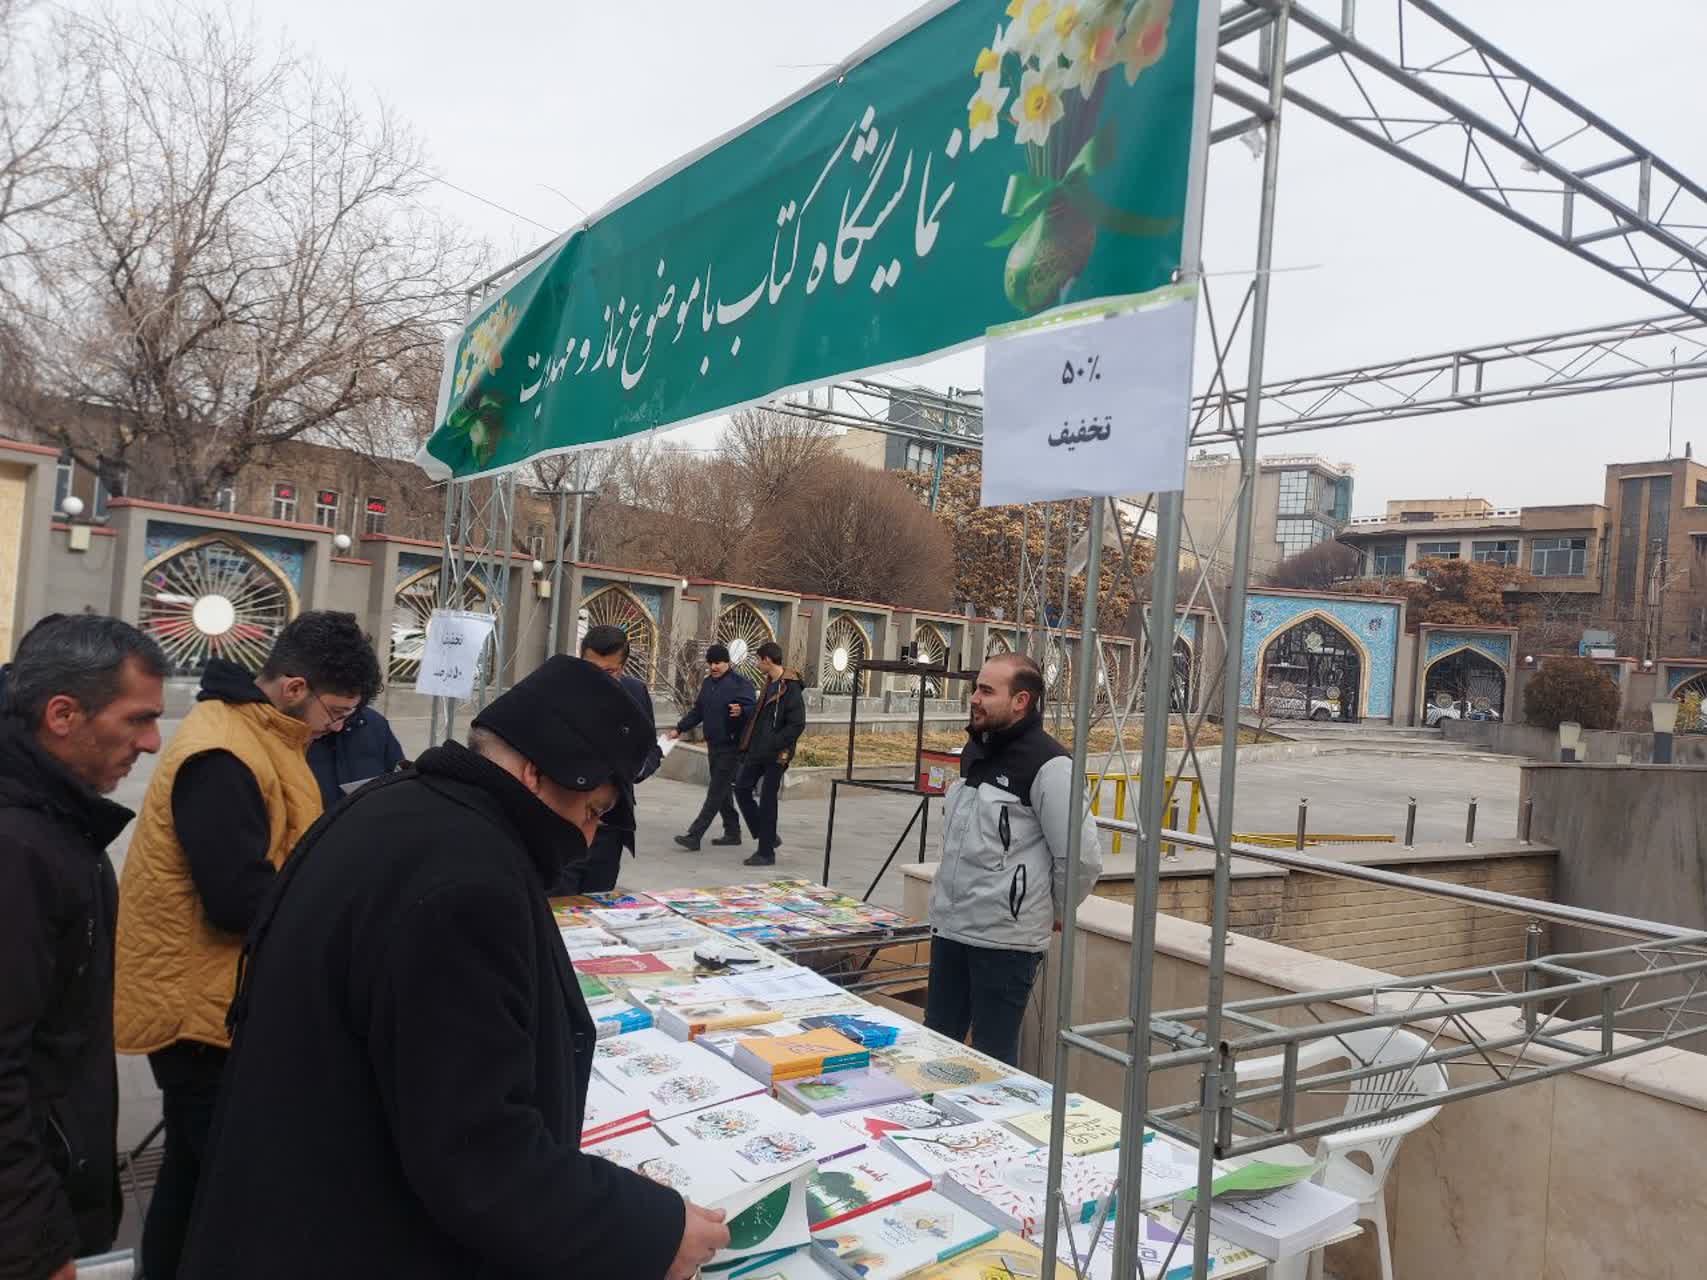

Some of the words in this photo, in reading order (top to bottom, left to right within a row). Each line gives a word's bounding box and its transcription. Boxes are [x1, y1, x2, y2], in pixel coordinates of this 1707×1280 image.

[716, 119, 857, 357] کتاب
[806, 104, 963, 294] نمایشگاه
[574, 338, 591, 376] و
[590, 296, 626, 373] نماز
[620, 258, 701, 391] موضوع
[699, 263, 715, 376] با
[1047, 415, 1113, 452] تخفیف
